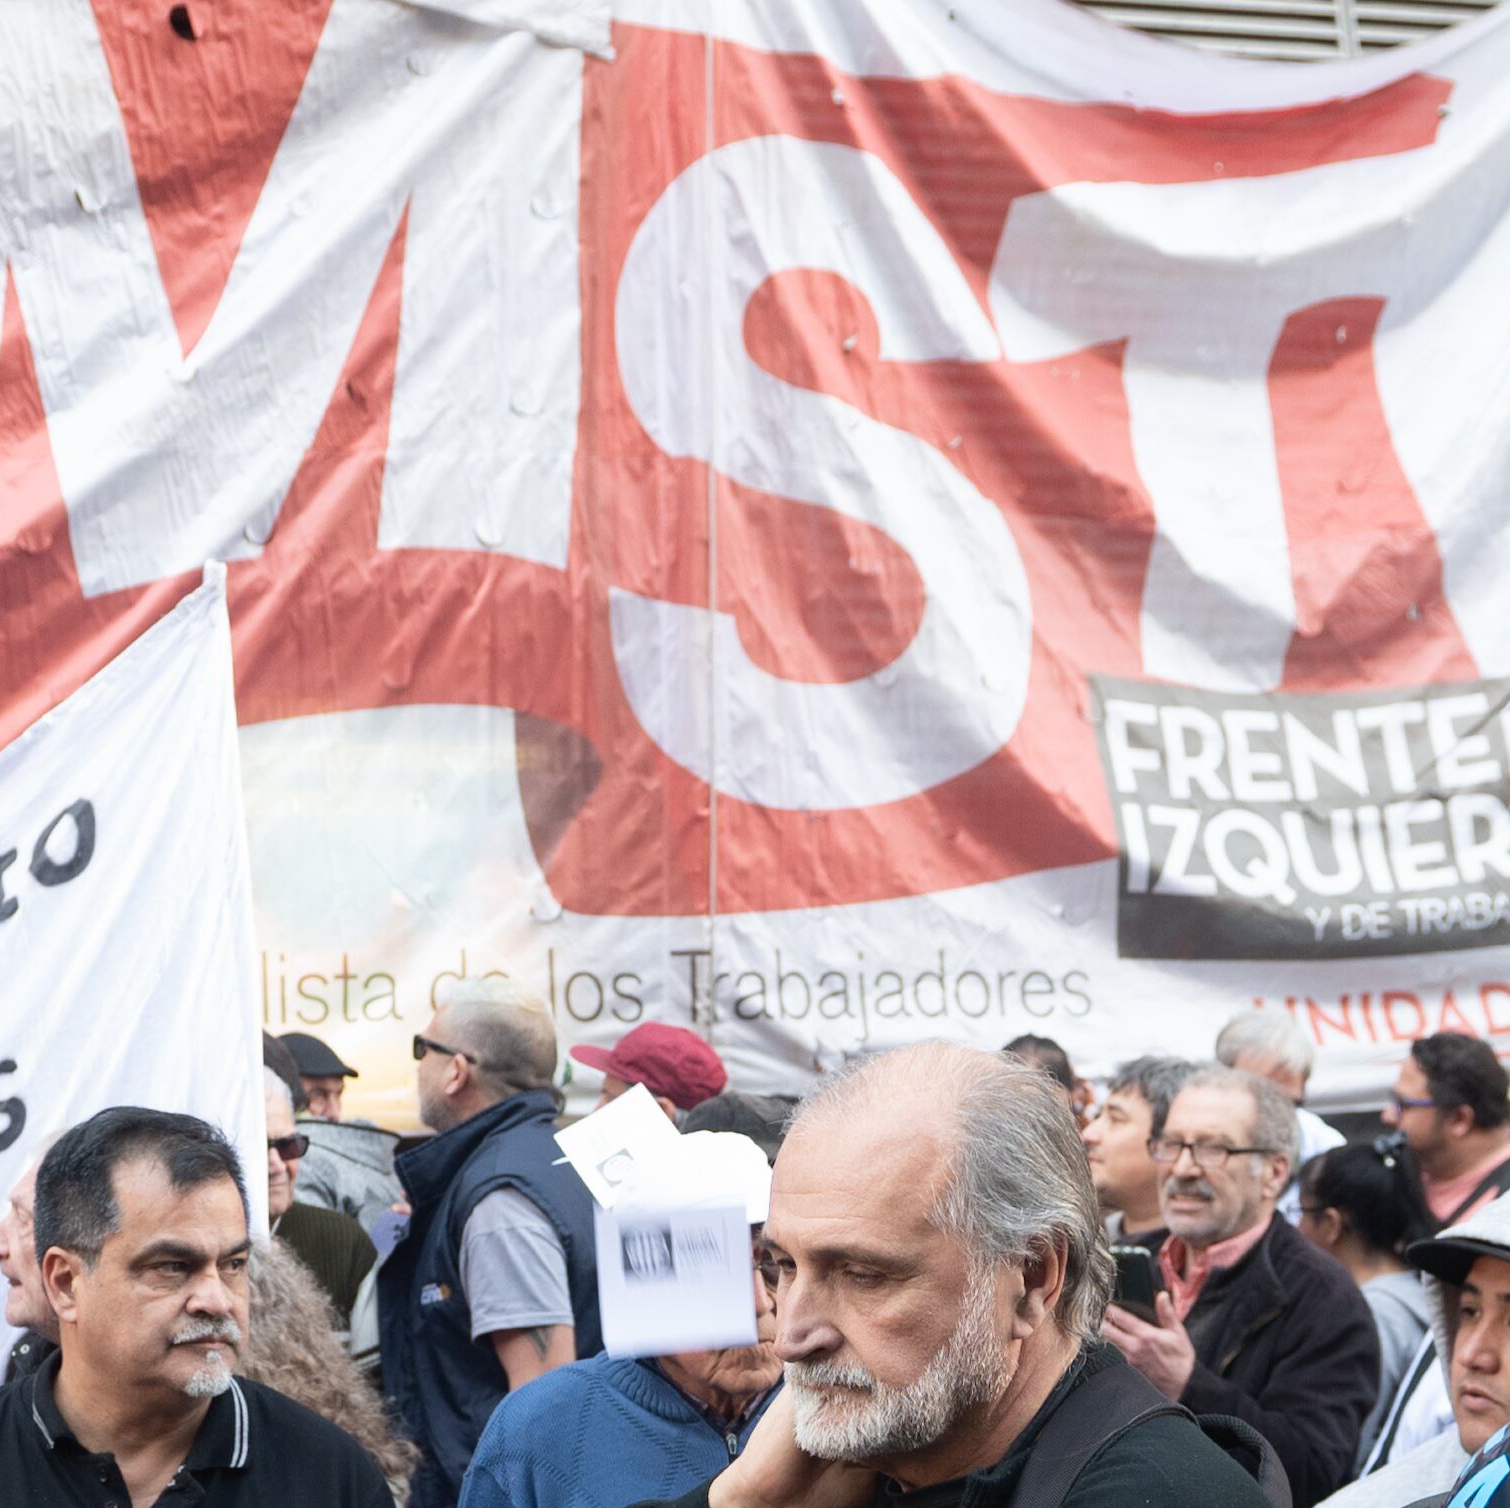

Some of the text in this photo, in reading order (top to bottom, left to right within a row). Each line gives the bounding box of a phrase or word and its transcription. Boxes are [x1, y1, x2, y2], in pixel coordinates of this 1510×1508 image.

[1103, 693, 1498, 802] FRENTE
[1304, 907, 1332, 942] Y
[1341, 902, 1393, 942] DE
[260, 950, 403, 1026] lista
[548, 947, 644, 1023] los
[669, 948, 1093, 1042] Trabajadores
